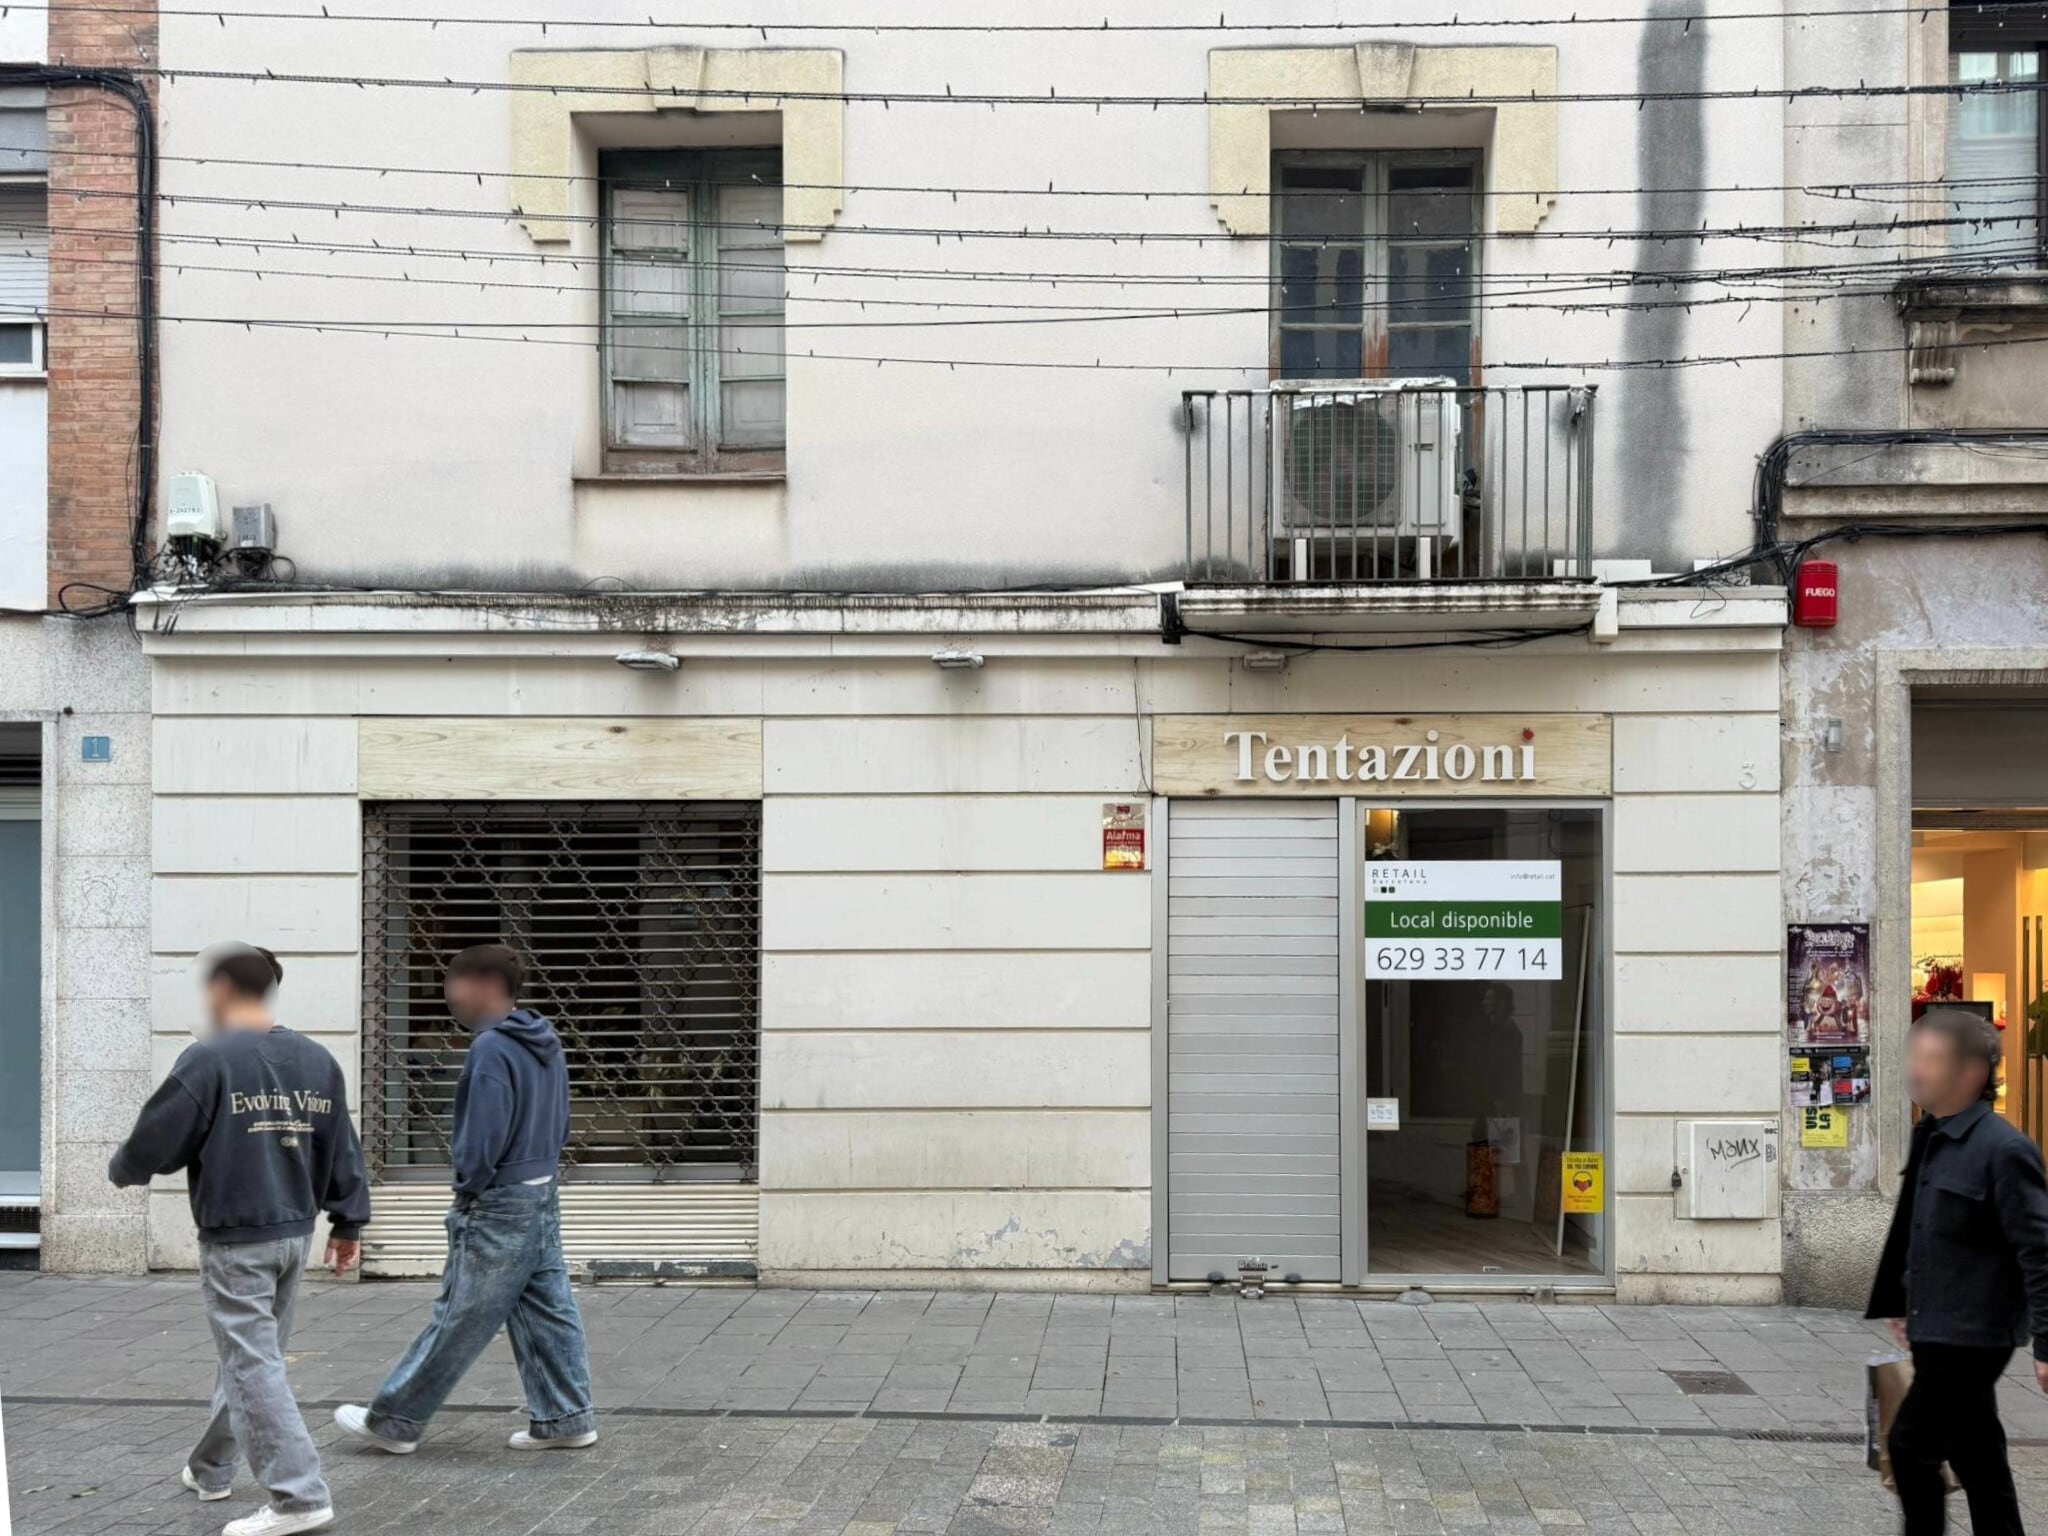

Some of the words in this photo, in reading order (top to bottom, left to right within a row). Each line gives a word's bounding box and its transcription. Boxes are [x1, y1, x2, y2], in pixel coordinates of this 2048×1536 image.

[1805, 587, 1835, 598] FUEGO
[1223, 727, 1536, 781] Tentazioni
[1738, 762, 1757, 790] 3
[1371, 868, 1427, 878] RETAIL
[1390, 911, 1435, 929] Local
[1442, 911, 1533, 933] disponible
[1377, 947, 1425, 971] 629
[1434, 947, 1465, 971] 33
[1475, 947, 1506, 971] 77
[1517, 947, 1548, 971] 14
